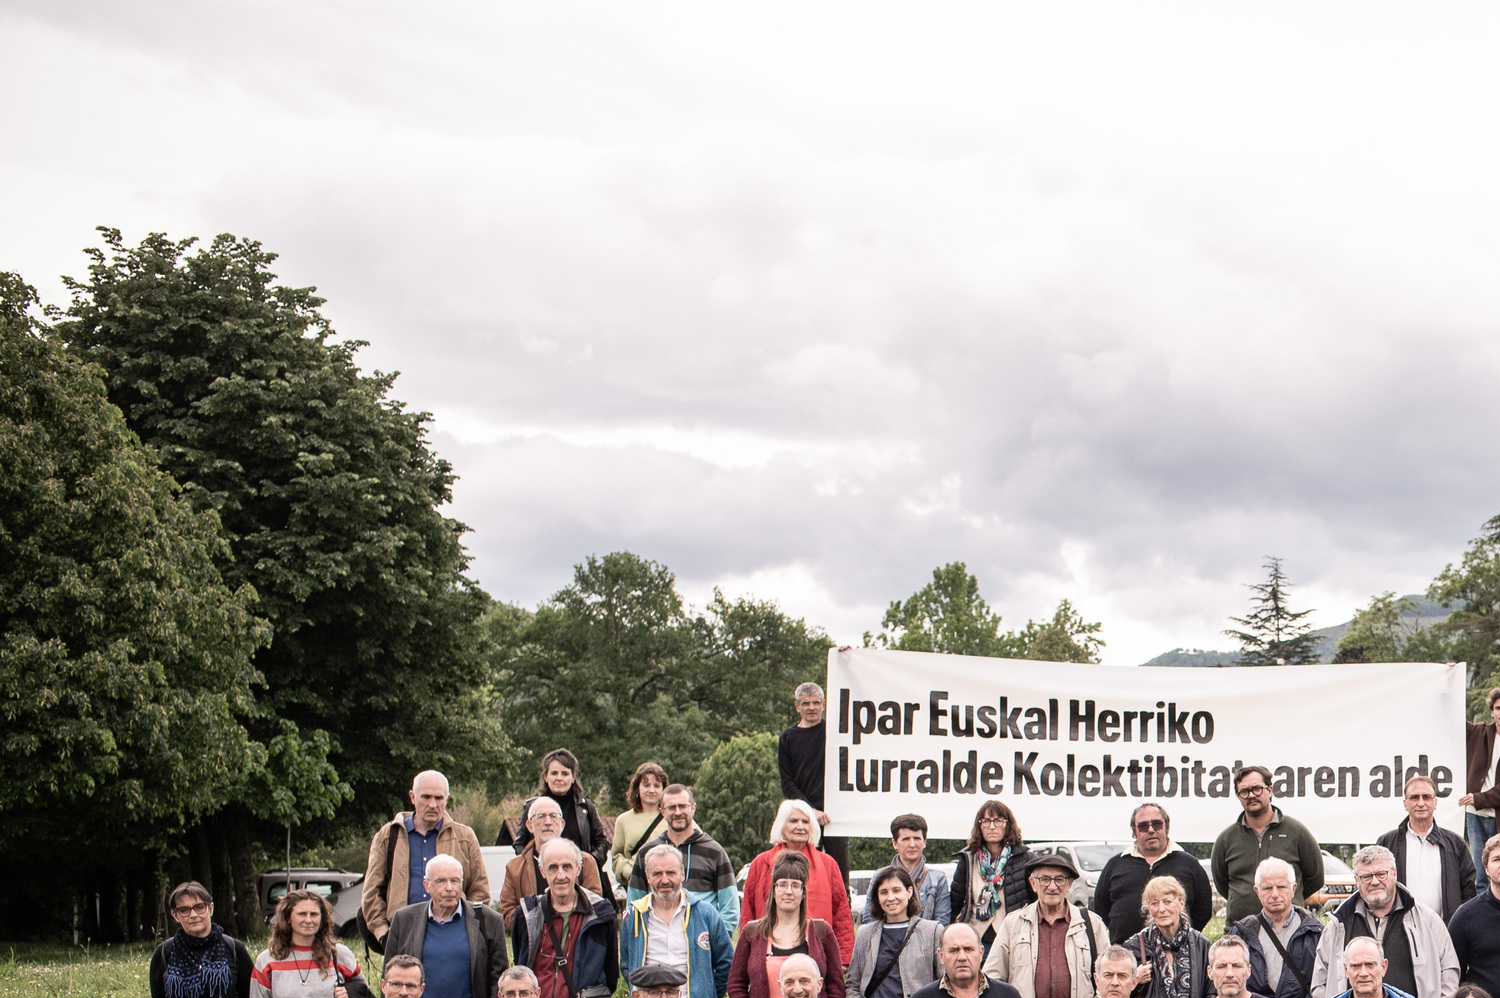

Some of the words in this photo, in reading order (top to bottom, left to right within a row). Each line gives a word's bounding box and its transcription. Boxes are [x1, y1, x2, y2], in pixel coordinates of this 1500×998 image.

[839, 689, 920, 744] Ipar
[930, 691, 1058, 740] Euskal
[1070, 700, 1214, 743] Herriko
[839, 747, 1003, 795] Lurralde
[1014, 752, 1359, 799] Kolektibitaaren
[1369, 755, 1452, 798] alde
